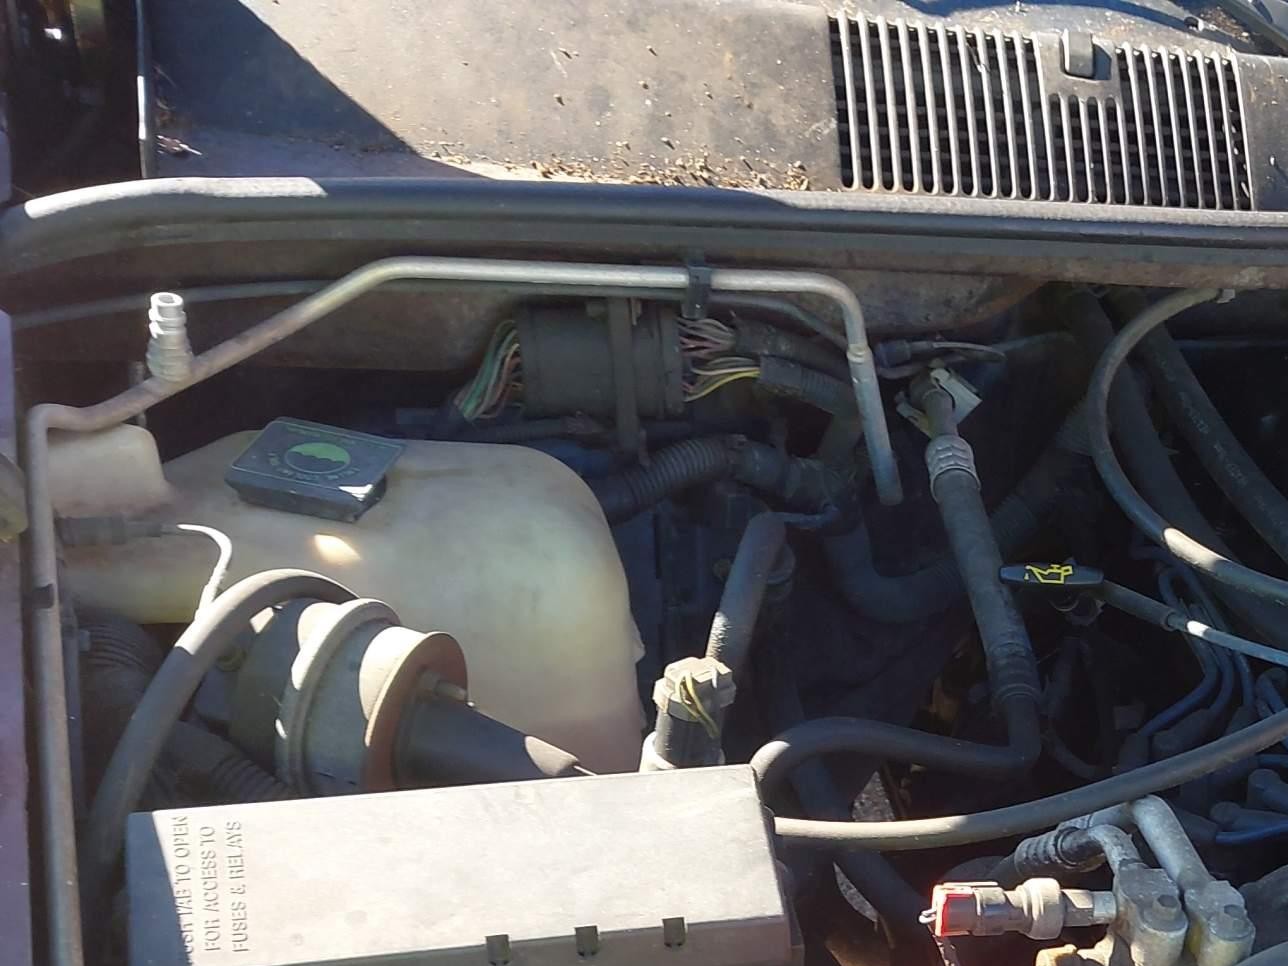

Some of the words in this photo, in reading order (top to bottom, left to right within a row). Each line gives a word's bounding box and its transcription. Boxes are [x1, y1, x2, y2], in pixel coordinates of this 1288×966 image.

[171, 816, 191, 859] OPEN
[199, 826, 216, 847] TO
[225, 820, 246, 880] RELAYS
[173, 864, 192, 885] TO
[200, 850, 220, 913] ACCESS
[203, 919, 221, 951] FOR
[230, 901, 249, 953] FUSES
